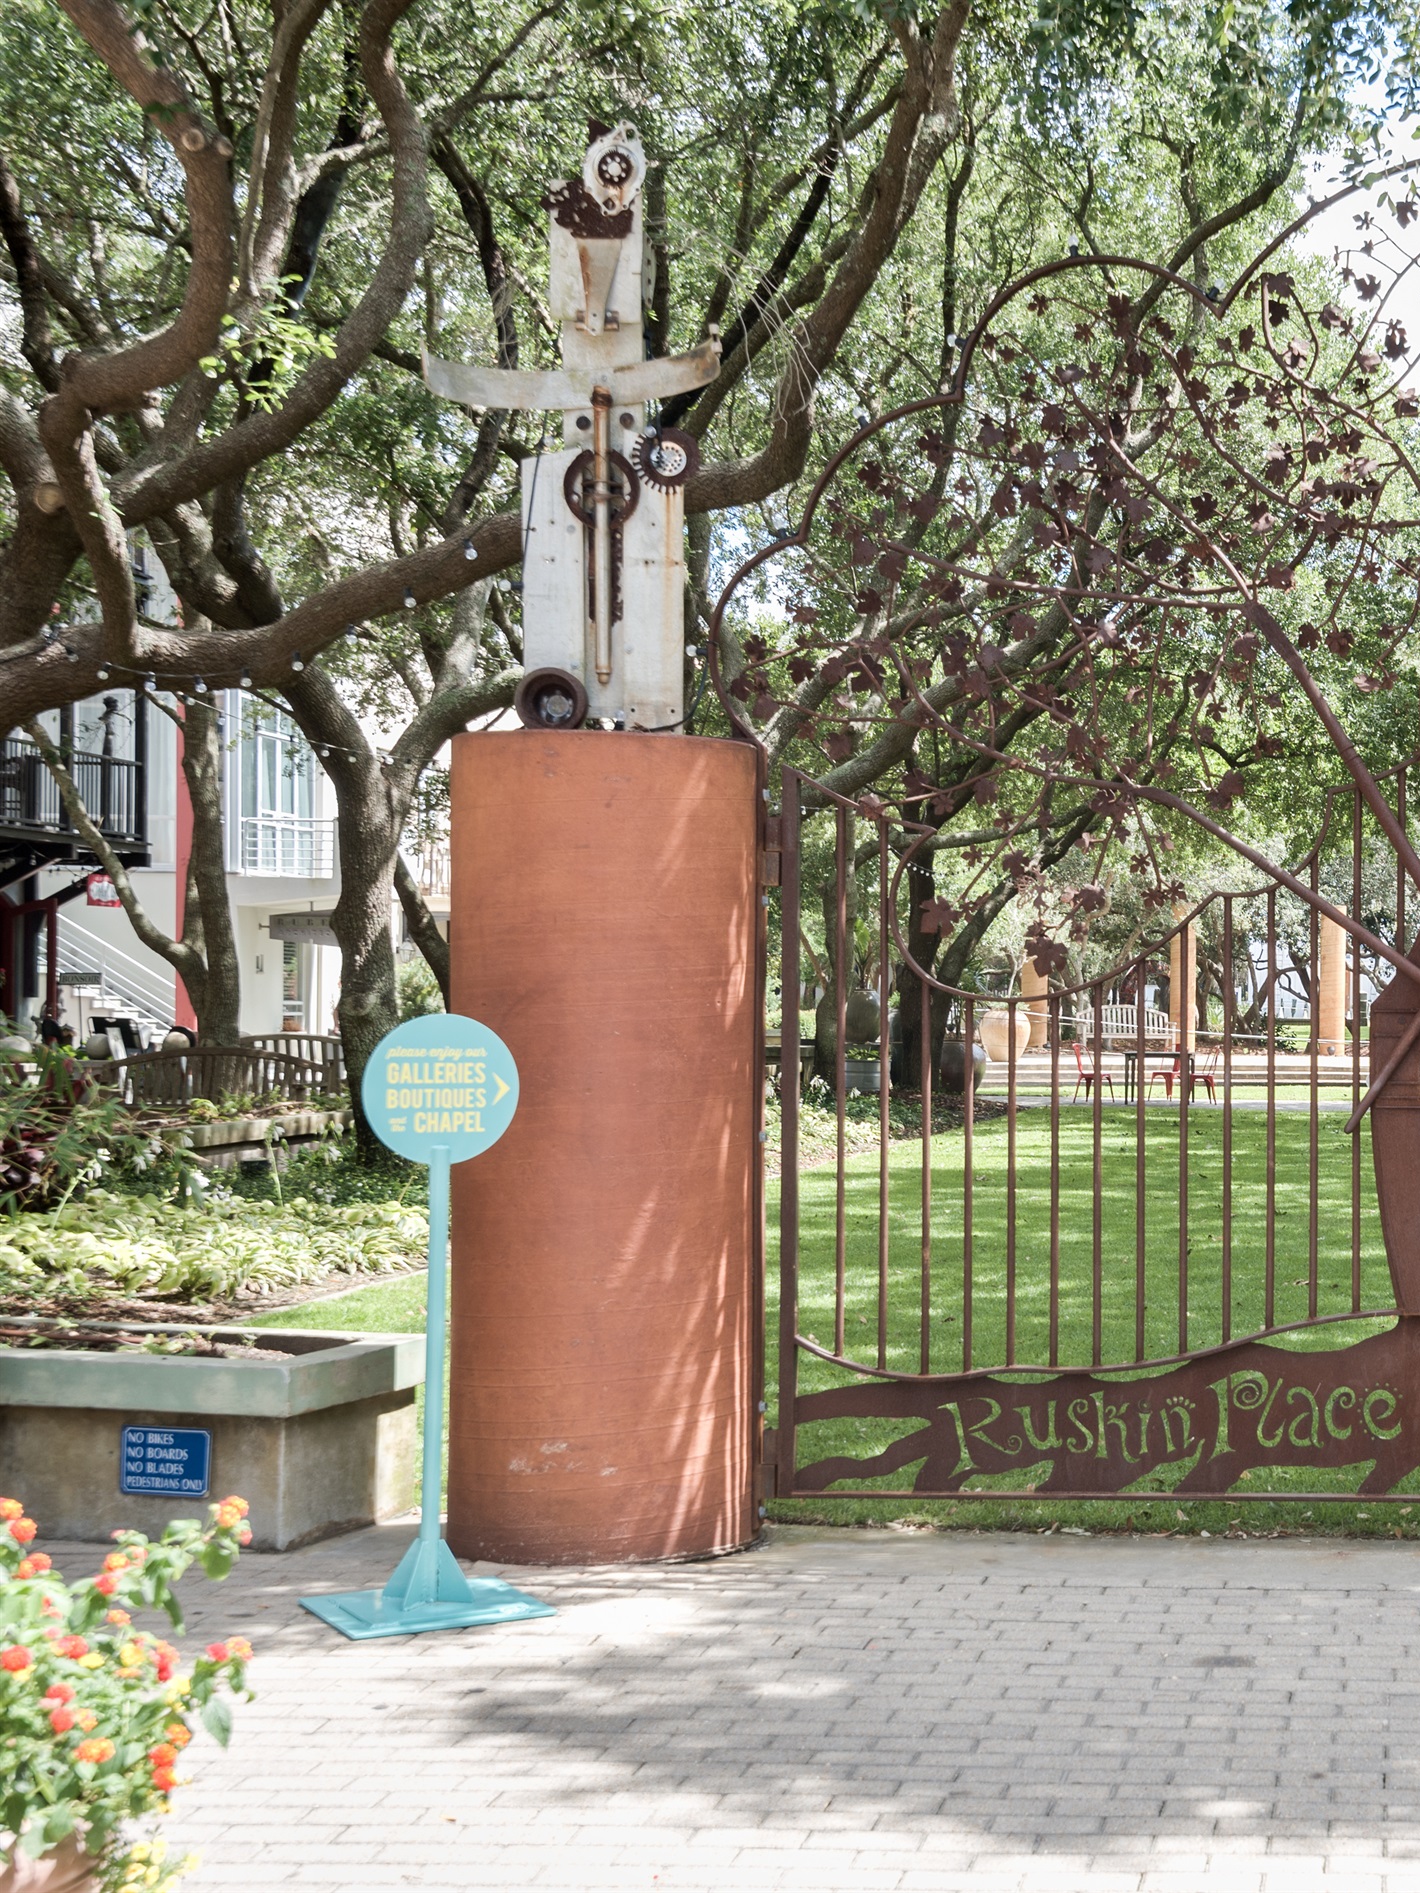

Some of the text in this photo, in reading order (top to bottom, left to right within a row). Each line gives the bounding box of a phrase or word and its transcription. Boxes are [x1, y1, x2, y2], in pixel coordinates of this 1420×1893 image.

[62, 975, 100, 983] BONSOIR
[385, 1046, 488, 1060] please enjoy our
[387, 1062, 486, 1084] GALLERIES
[386, 1088, 487, 1109] BOUTIQUES
[414, 1111, 485, 1133] CHAPEL
[937, 1390, 1196, 1478] Ruskin
[1205, 1369, 1403, 1463] Place
[128, 1432, 174, 1445] NO BIKES
[127, 1446, 189, 1461] NO BOARDS
[126, 1461, 184, 1475] NO BLADES
[126, 1475, 204, 1490] PEDESTRIANS ONLY
